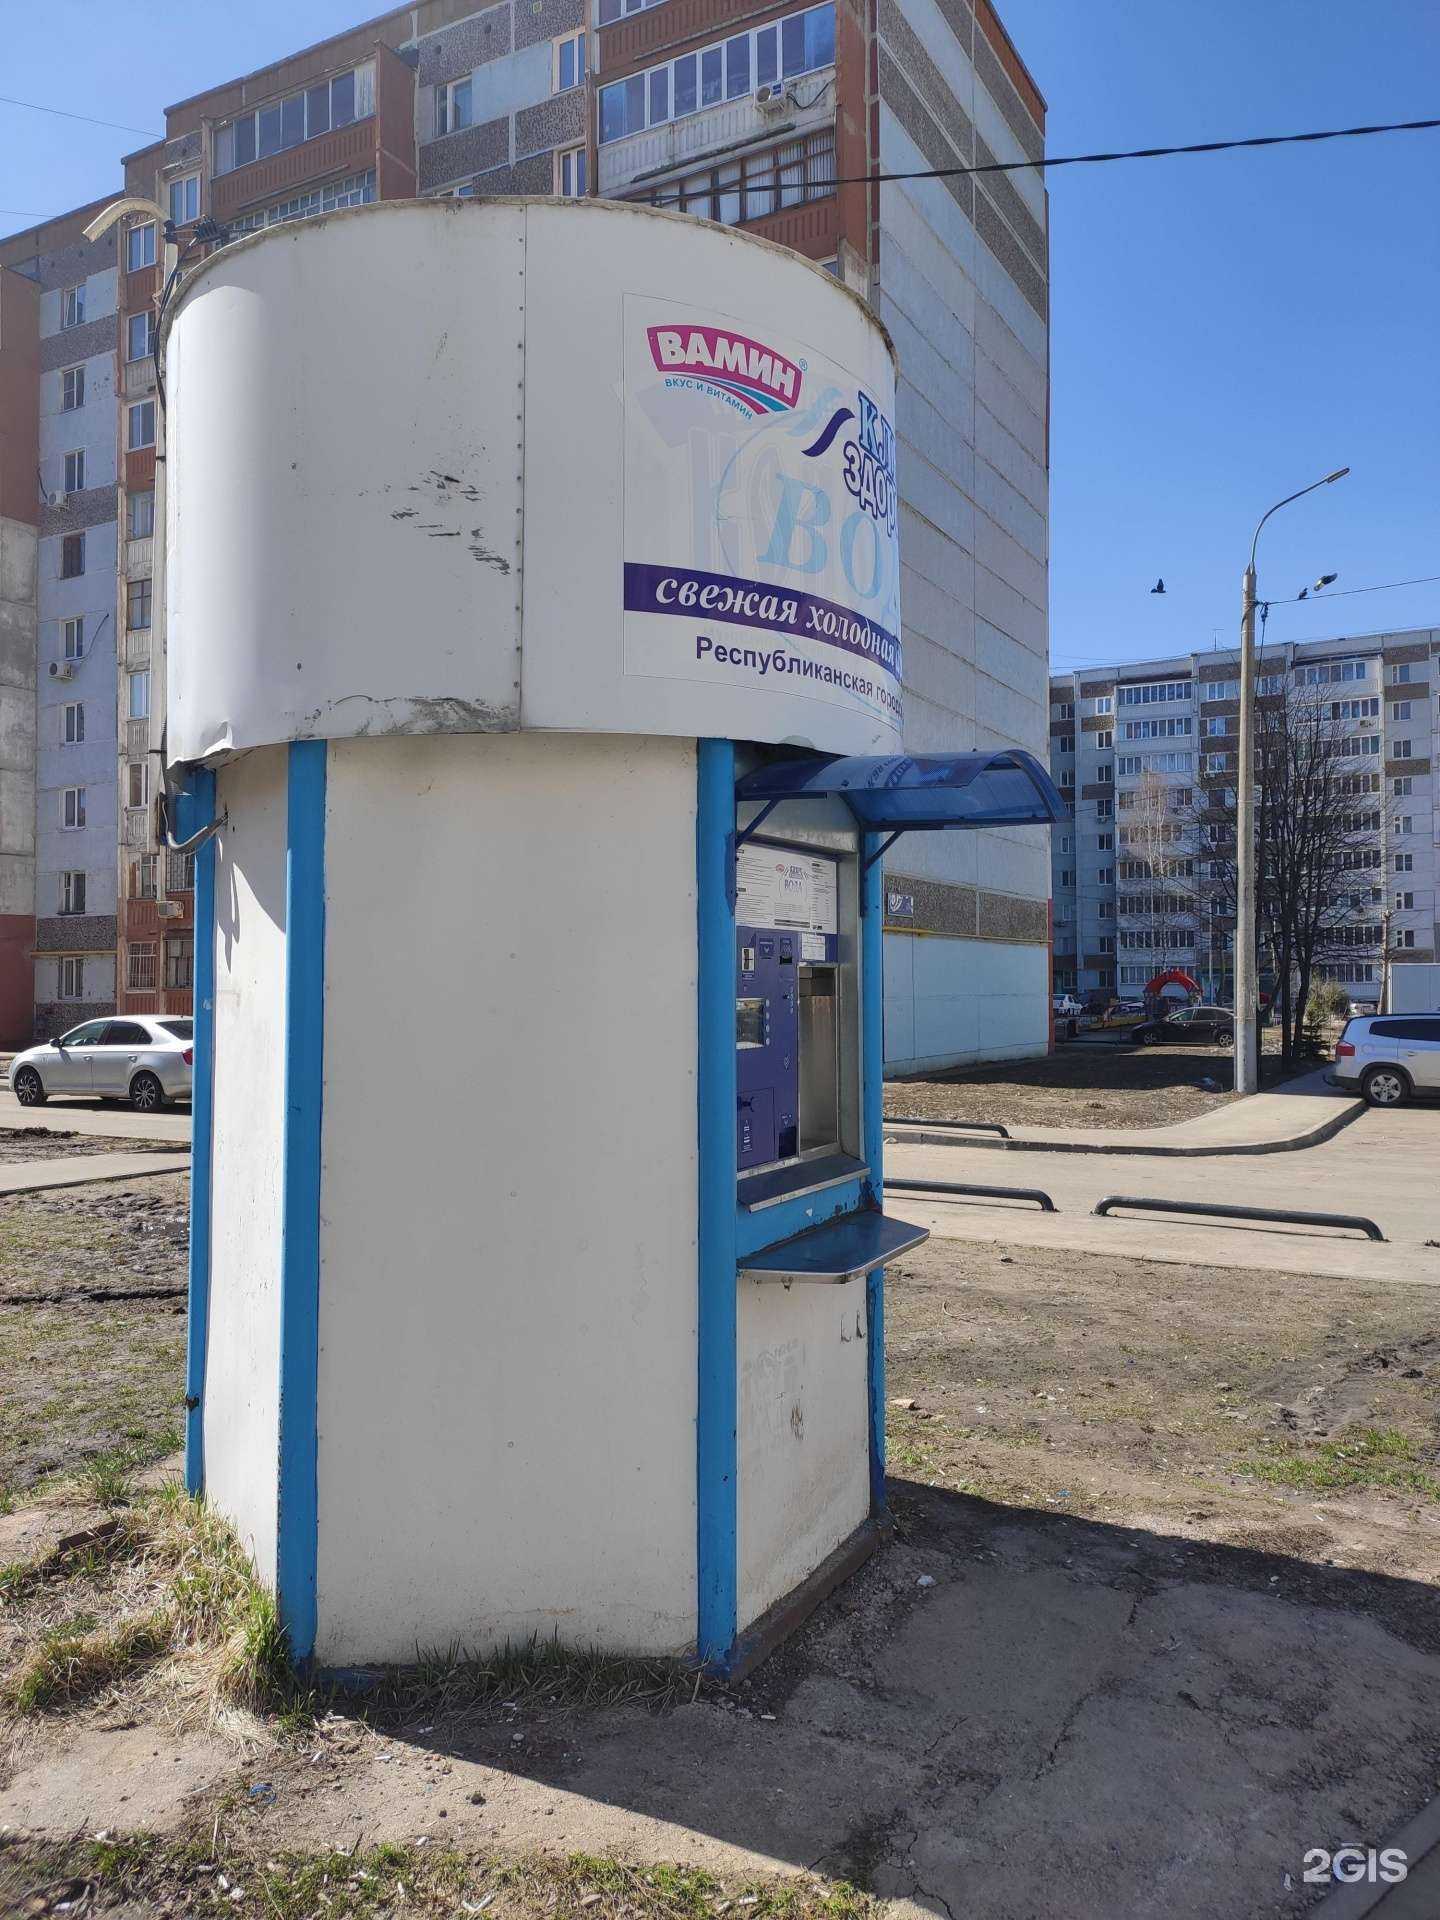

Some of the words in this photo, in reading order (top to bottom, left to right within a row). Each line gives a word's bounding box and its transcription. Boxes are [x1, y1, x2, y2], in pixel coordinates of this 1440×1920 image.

[657, 331, 796, 399] ВАМИН
[664, 378, 694, 388] ВКУС
[696, 380, 703, 390] И
[706, 385, 753, 419] ВИТАМИН
[655, 577, 800, 625] свежая
[805, 605, 895, 667] холодная
[696, 635, 873, 698] Республиканская
